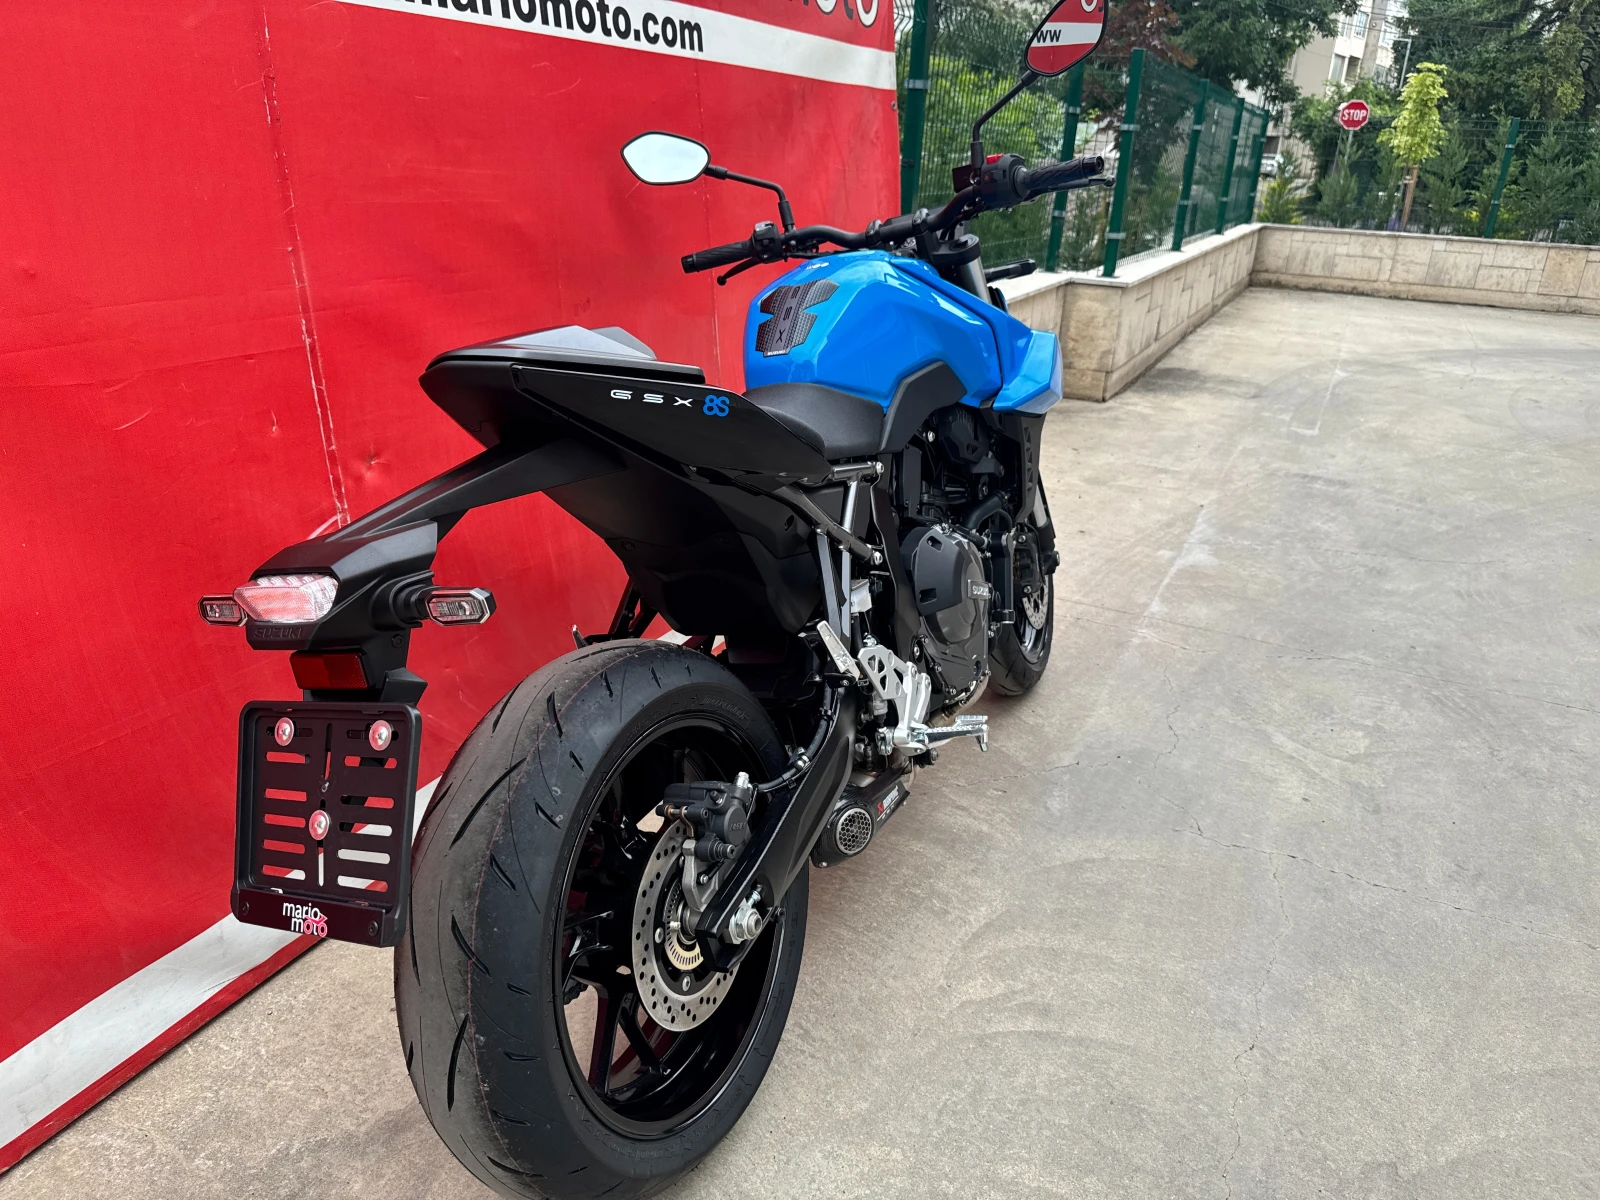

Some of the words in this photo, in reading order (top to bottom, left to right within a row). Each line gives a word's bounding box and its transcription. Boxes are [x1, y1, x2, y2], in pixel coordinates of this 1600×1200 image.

[1342, 109, 1367, 121] STOP
[610, 389, 694, 408] GSX
[702, 394, 730, 417] 8S
[253, 626, 303, 640] SUZUKI
[282, 902, 321, 919] mario
[291, 917, 328, 937] moto
